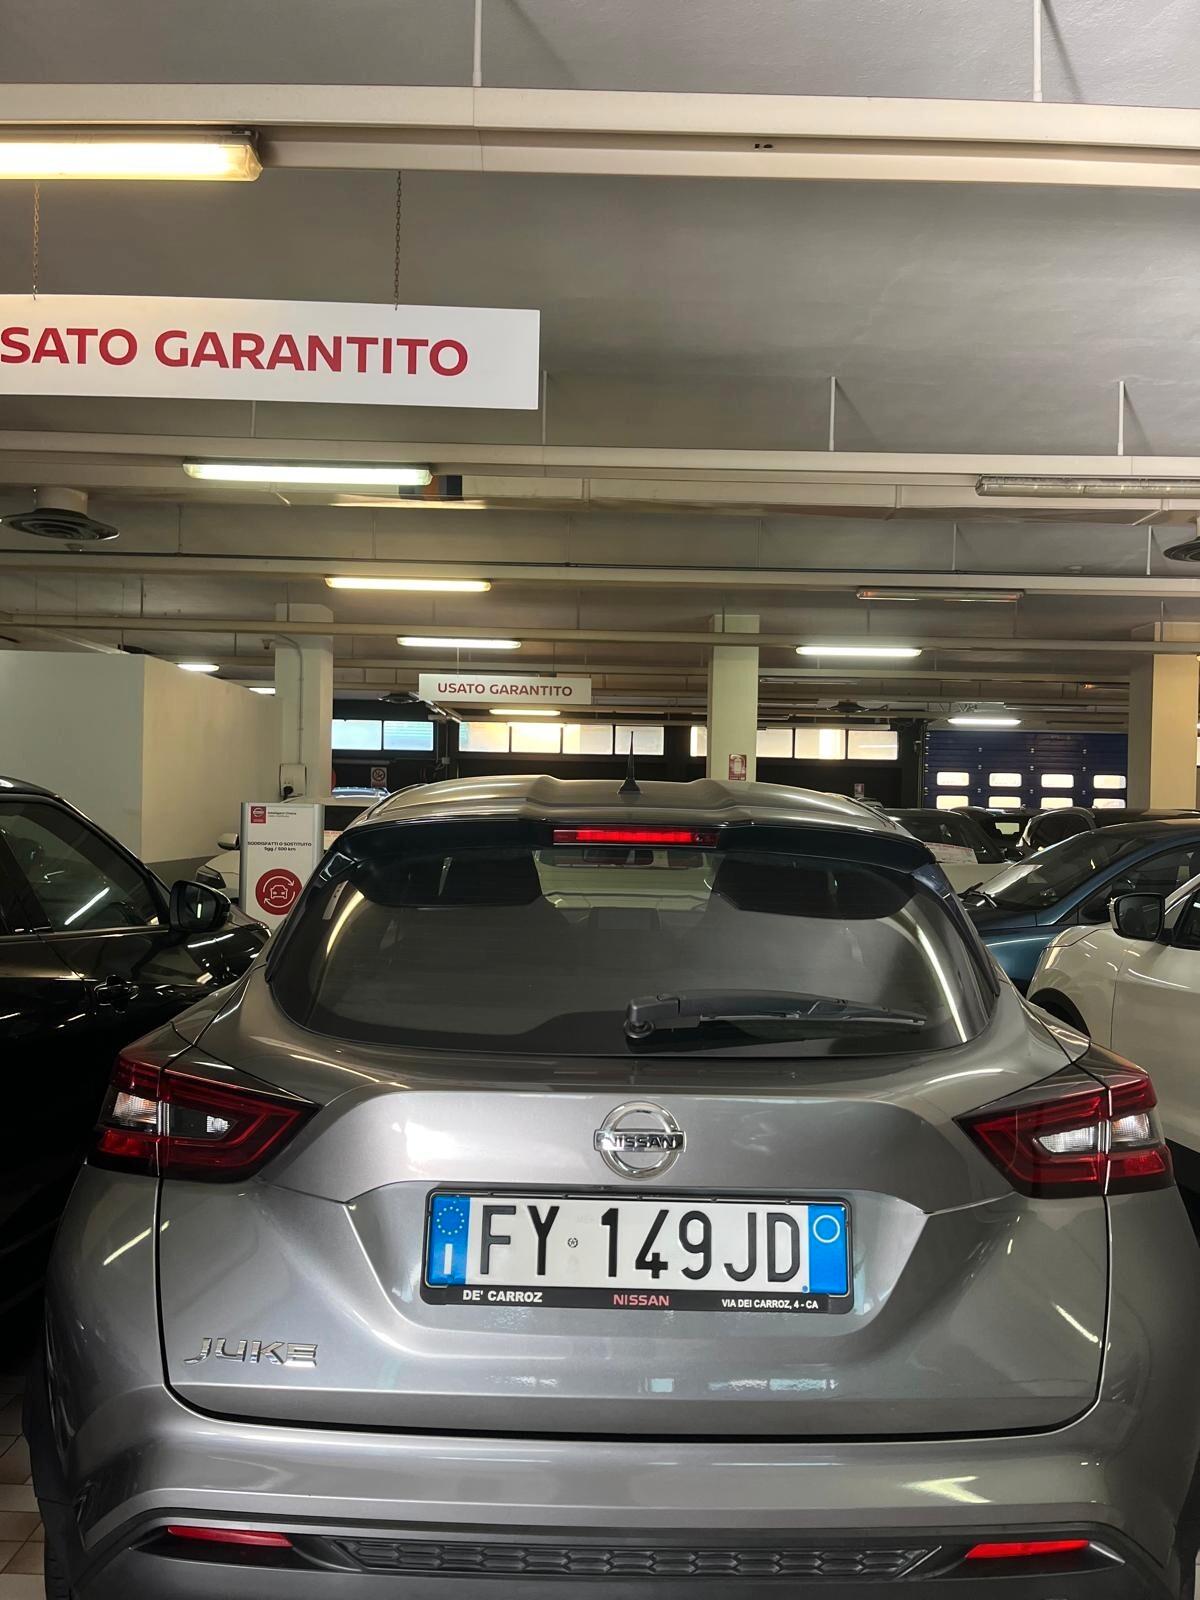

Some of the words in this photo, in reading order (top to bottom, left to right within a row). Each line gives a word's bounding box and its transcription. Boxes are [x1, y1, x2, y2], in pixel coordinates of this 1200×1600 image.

[155, 330, 469, 376] GARANTITO
[437, 682, 486, 694] USATO
[489, 684, 573, 697] GARANTITO
[604, 1135, 678, 1149] NISSAN
[480, 1205, 560, 1276] FY
[463, 1289, 484, 1302] DE'
[488, 1290, 543, 1303] CARROZ
[613, 1294, 670, 1307] NISSAN
[721, 1299, 736, 1308] VIA
[738, 1299, 752, 1308] DEI
[754, 1300, 792, 1310] CARROZ,
[793, 1300, 799, 1308] 4
[806, 1300, 819, 1309] CA
[184, 1337, 318, 1368] JUKE
